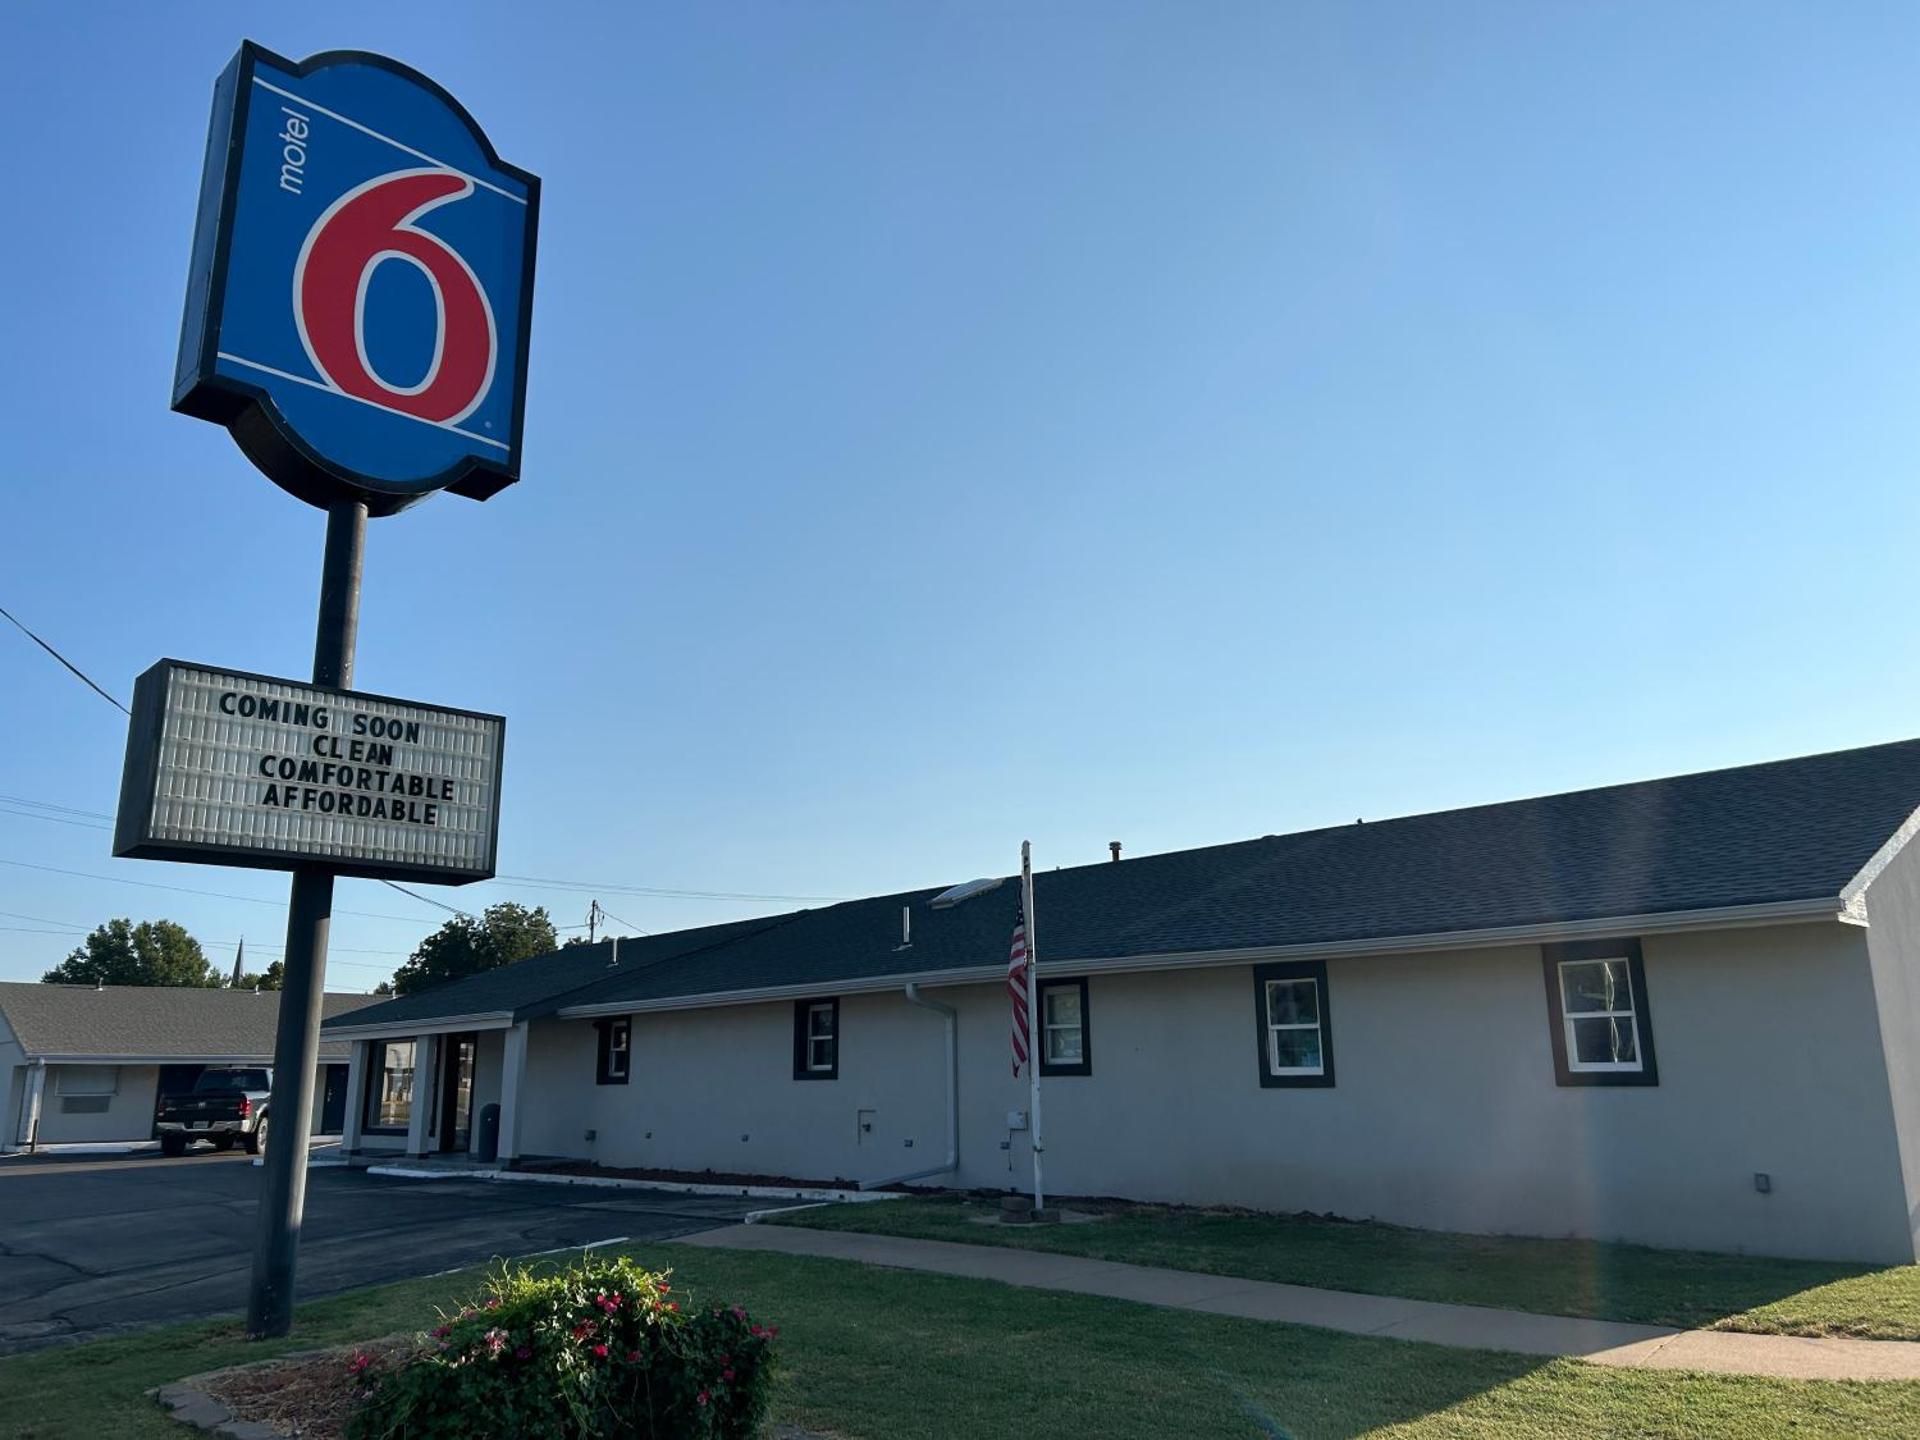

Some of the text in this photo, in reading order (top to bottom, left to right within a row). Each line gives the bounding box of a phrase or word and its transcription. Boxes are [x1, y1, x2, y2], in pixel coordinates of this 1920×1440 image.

[279, 107, 309, 194] motel
[293, 167, 497, 427] 6
[220, 692, 420, 744] COMING SOON
[313, 735, 393, 766] CLEAN
[260, 755, 454, 801] COMFORTABLE
[263, 784, 438, 825] AFFORDABLE
